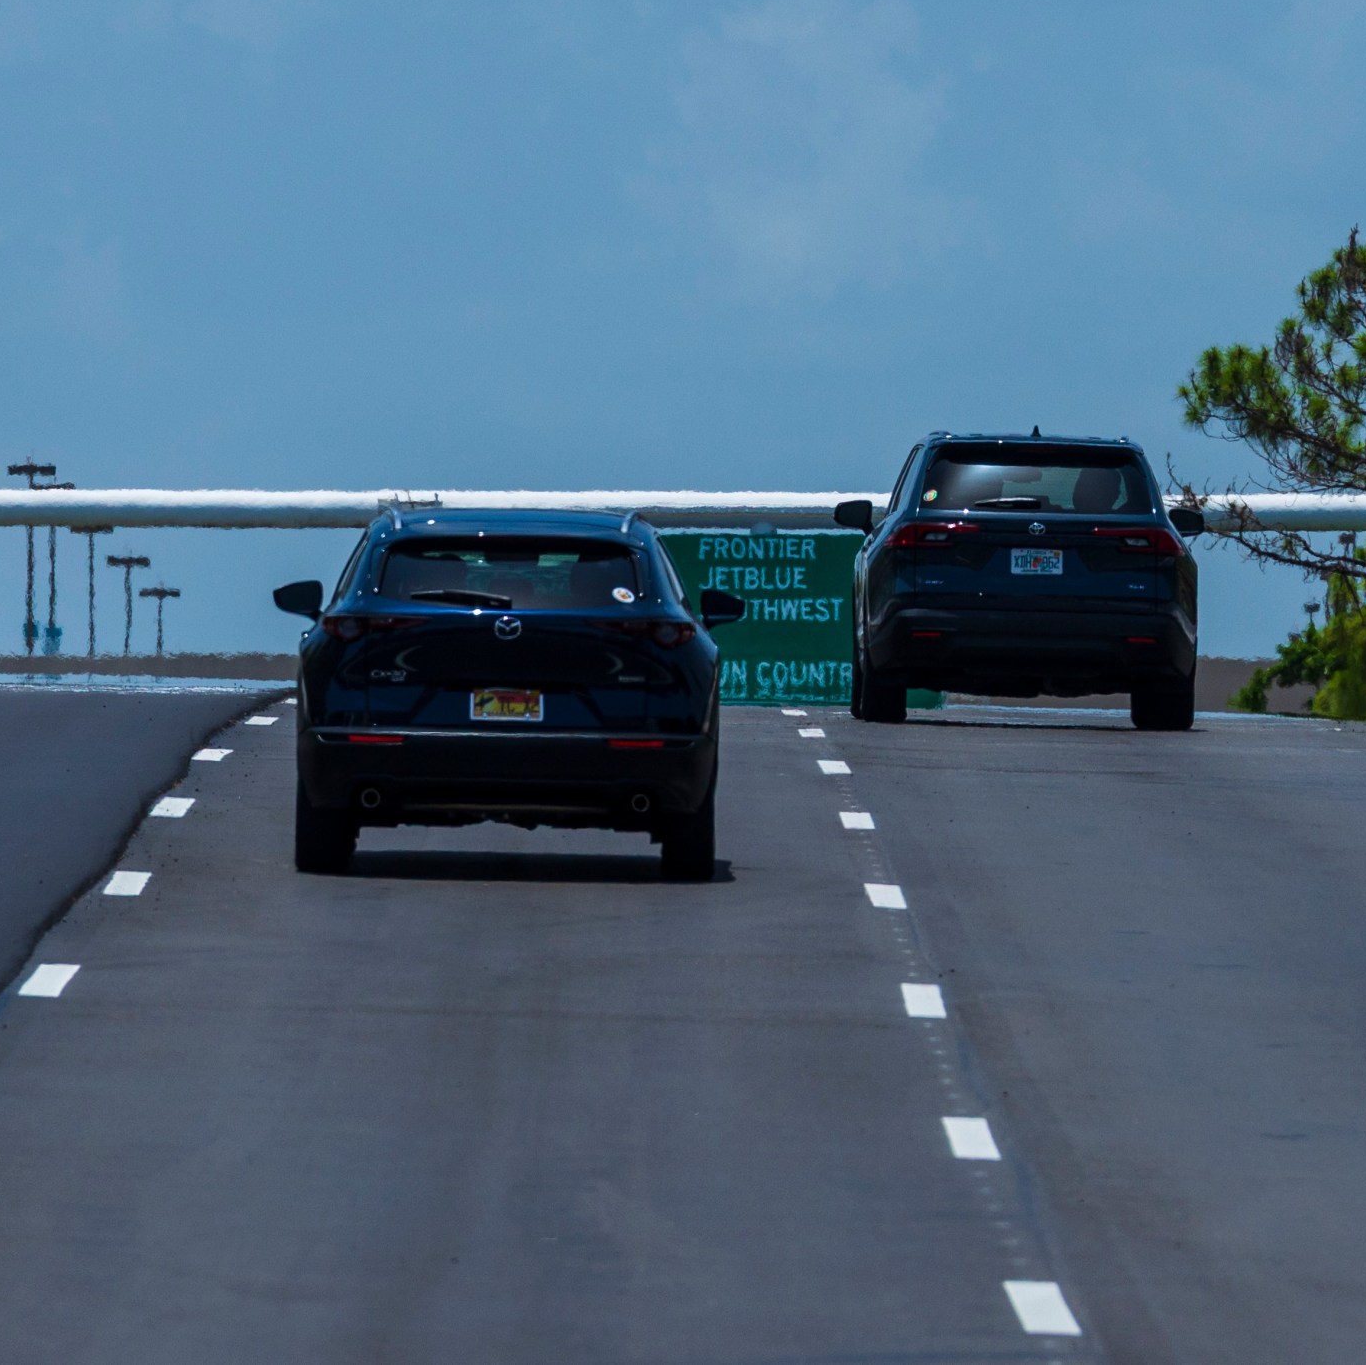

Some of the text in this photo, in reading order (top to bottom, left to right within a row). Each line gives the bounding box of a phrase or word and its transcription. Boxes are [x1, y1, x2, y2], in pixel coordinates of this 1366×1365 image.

[698, 537, 816, 560] FRONTIER
[698, 566, 808, 590] JETBLUE
[738, 597, 844, 622] THWEST
[756, 661, 852, 688] COUNTR
